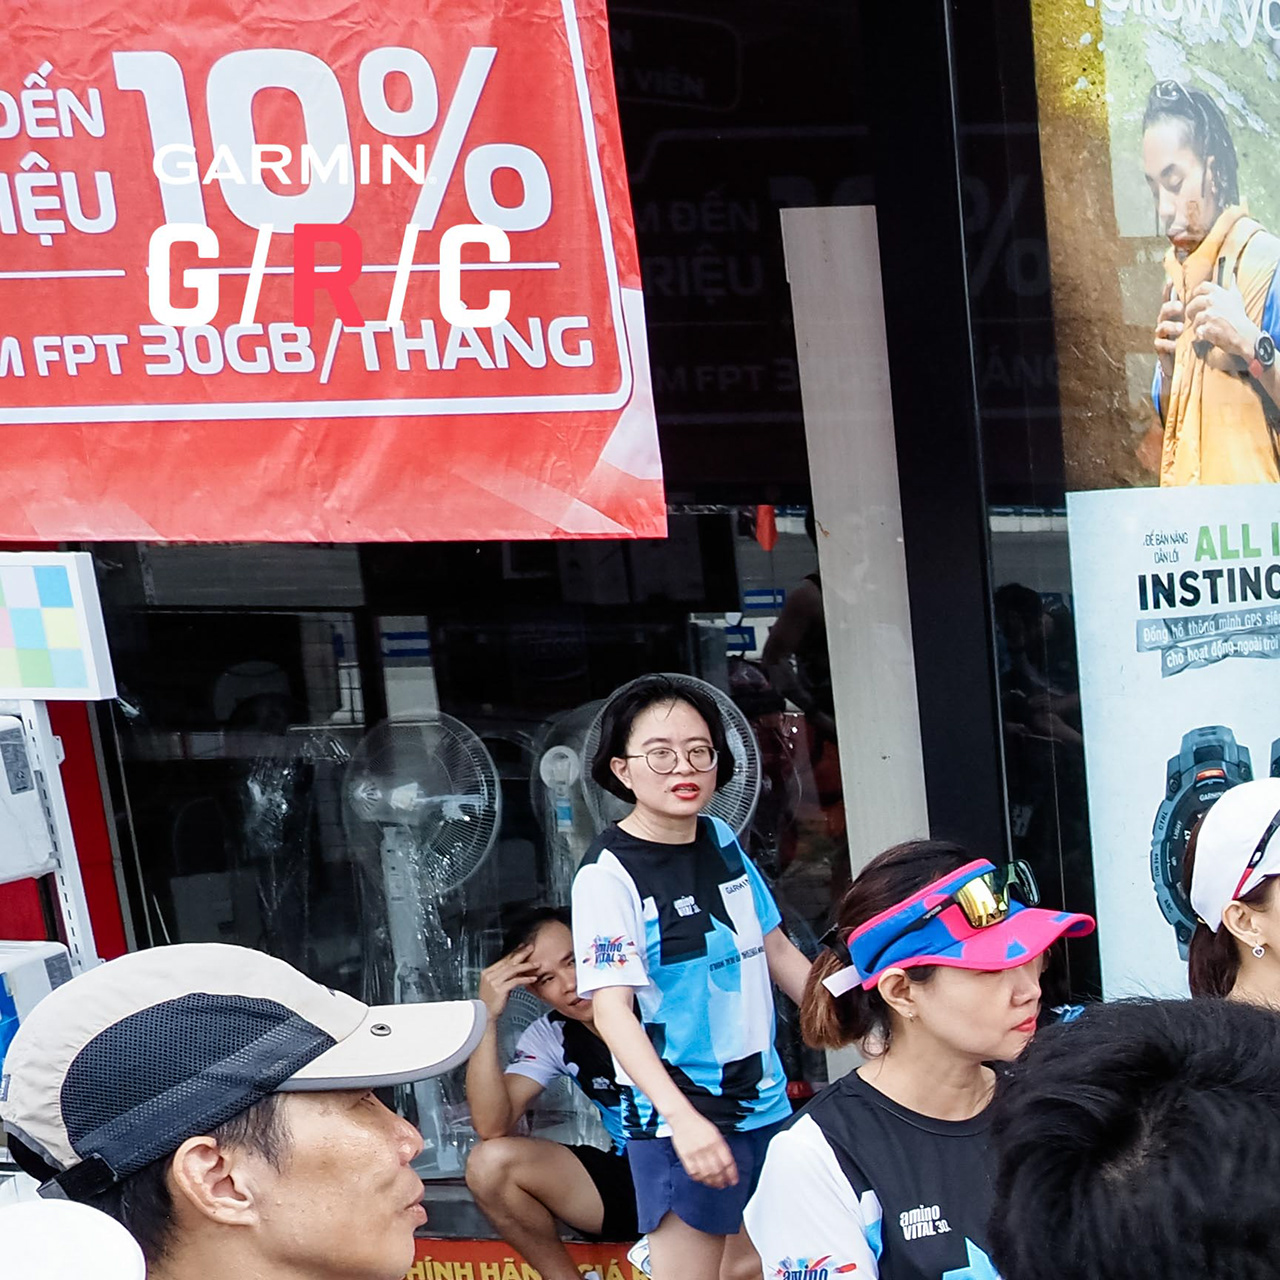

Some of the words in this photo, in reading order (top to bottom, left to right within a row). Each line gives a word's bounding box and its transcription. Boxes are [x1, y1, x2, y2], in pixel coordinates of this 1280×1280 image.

[112, 46, 552, 233] 10%
[34, 334, 128, 376] FPT
[1194, 523, 1261, 562] ALL
[1245, 612, 1262, 626] GPS
[900, 1204, 940, 1227] amino
[902, 1222, 936, 1241] VITAL
